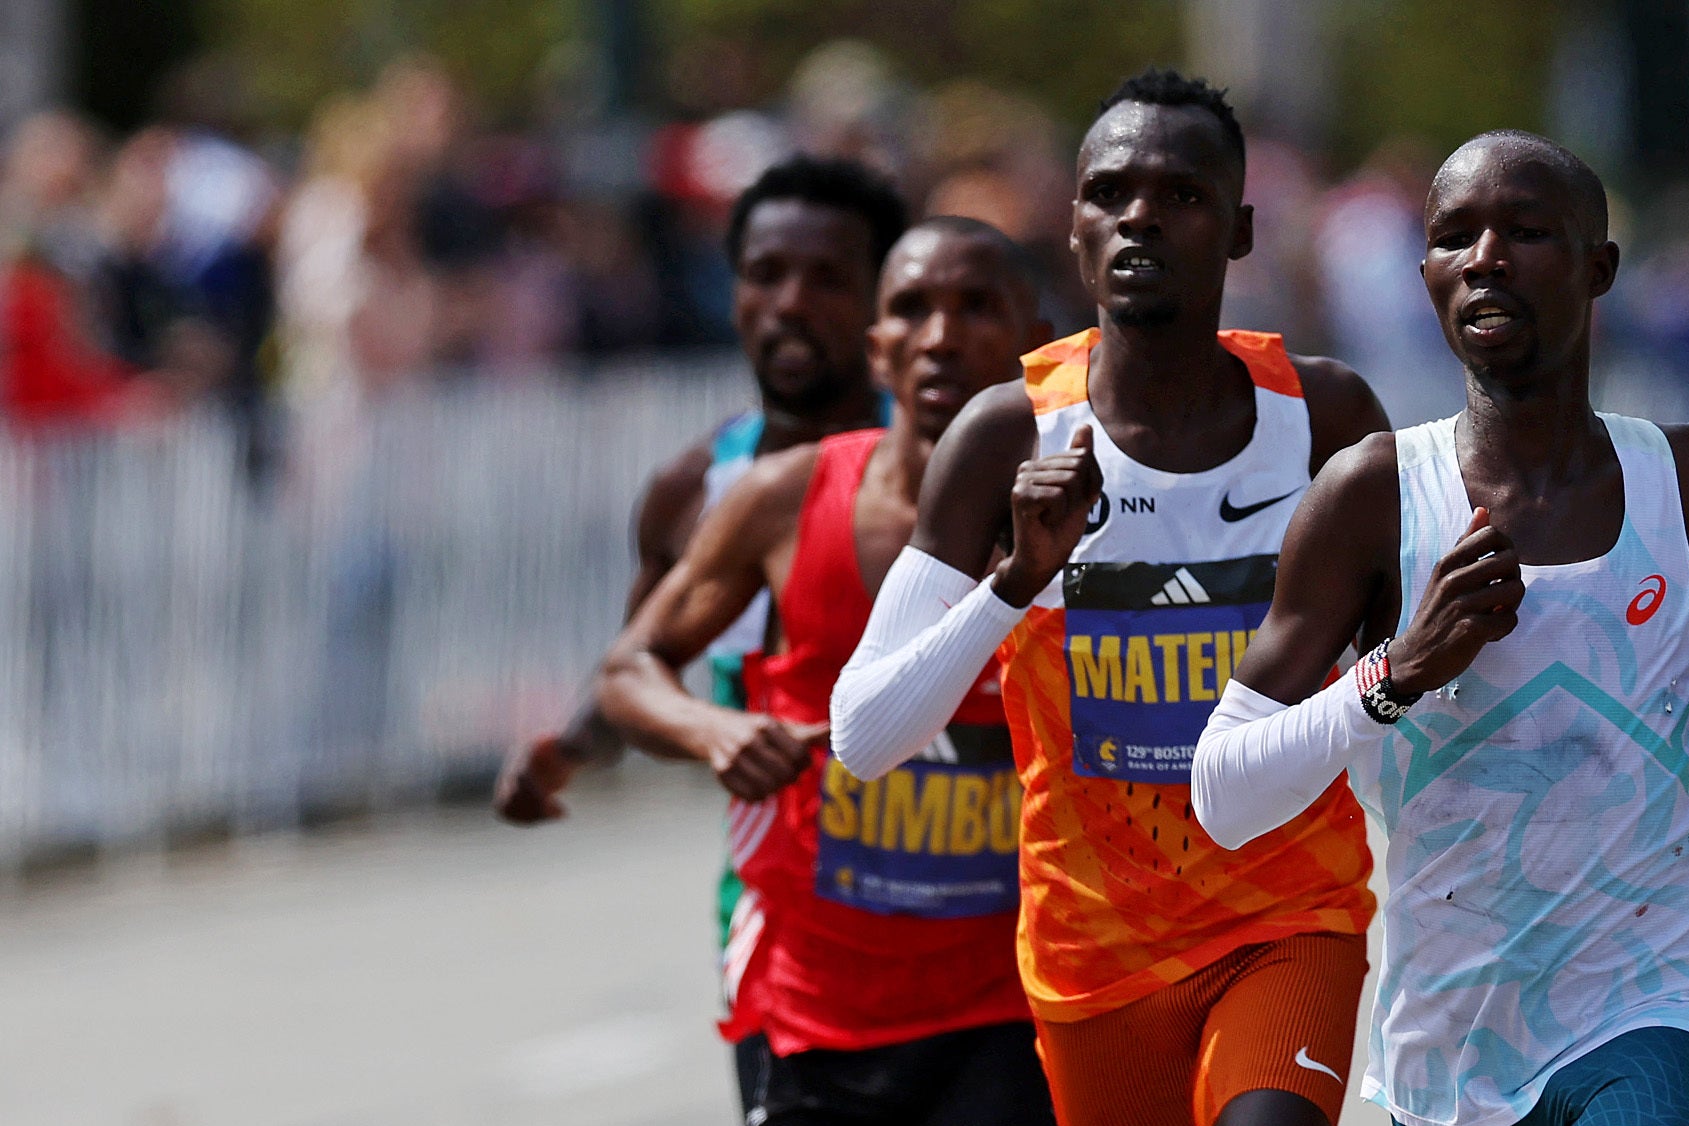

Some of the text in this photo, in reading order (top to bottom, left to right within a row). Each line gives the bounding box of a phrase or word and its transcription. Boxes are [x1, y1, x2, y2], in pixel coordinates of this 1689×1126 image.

[1120, 497, 1156, 514] NN
[1069, 629, 1257, 704] MATEI
[1153, 744, 1197, 761] BOSTO
[821, 757, 1023, 856] SIMBU
